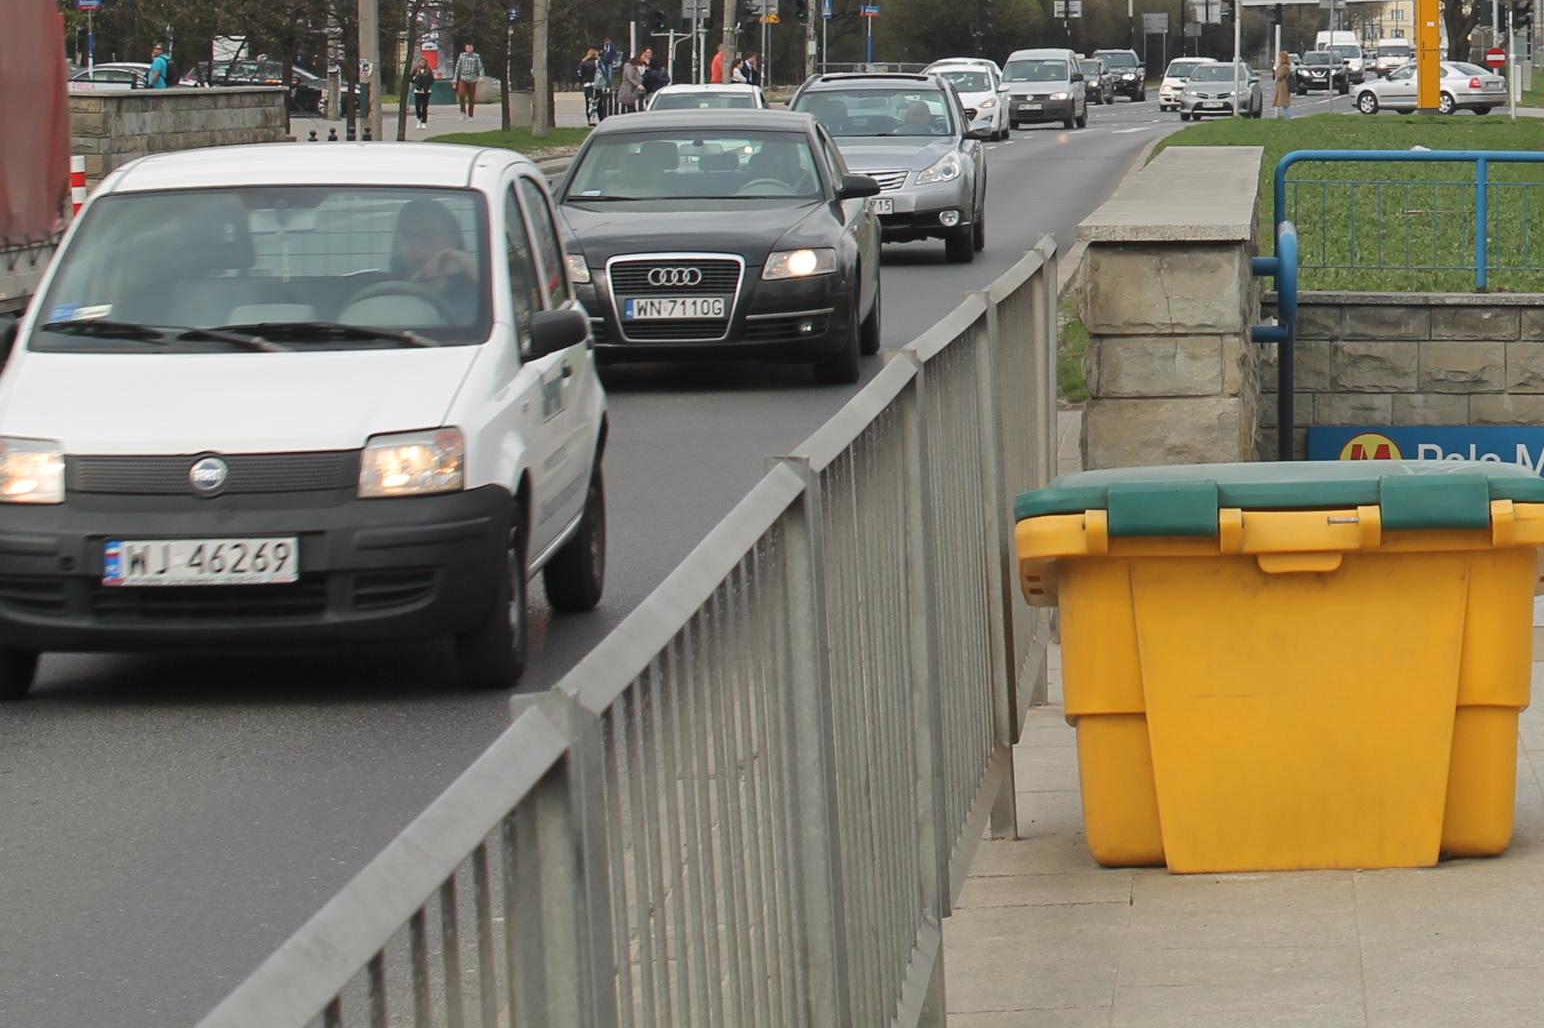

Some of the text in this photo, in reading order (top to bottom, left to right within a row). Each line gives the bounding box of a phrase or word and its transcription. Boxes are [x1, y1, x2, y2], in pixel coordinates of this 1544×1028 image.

[636, 299, 723, 317] WN 7110G
[187, 542, 292, 575] 46269
